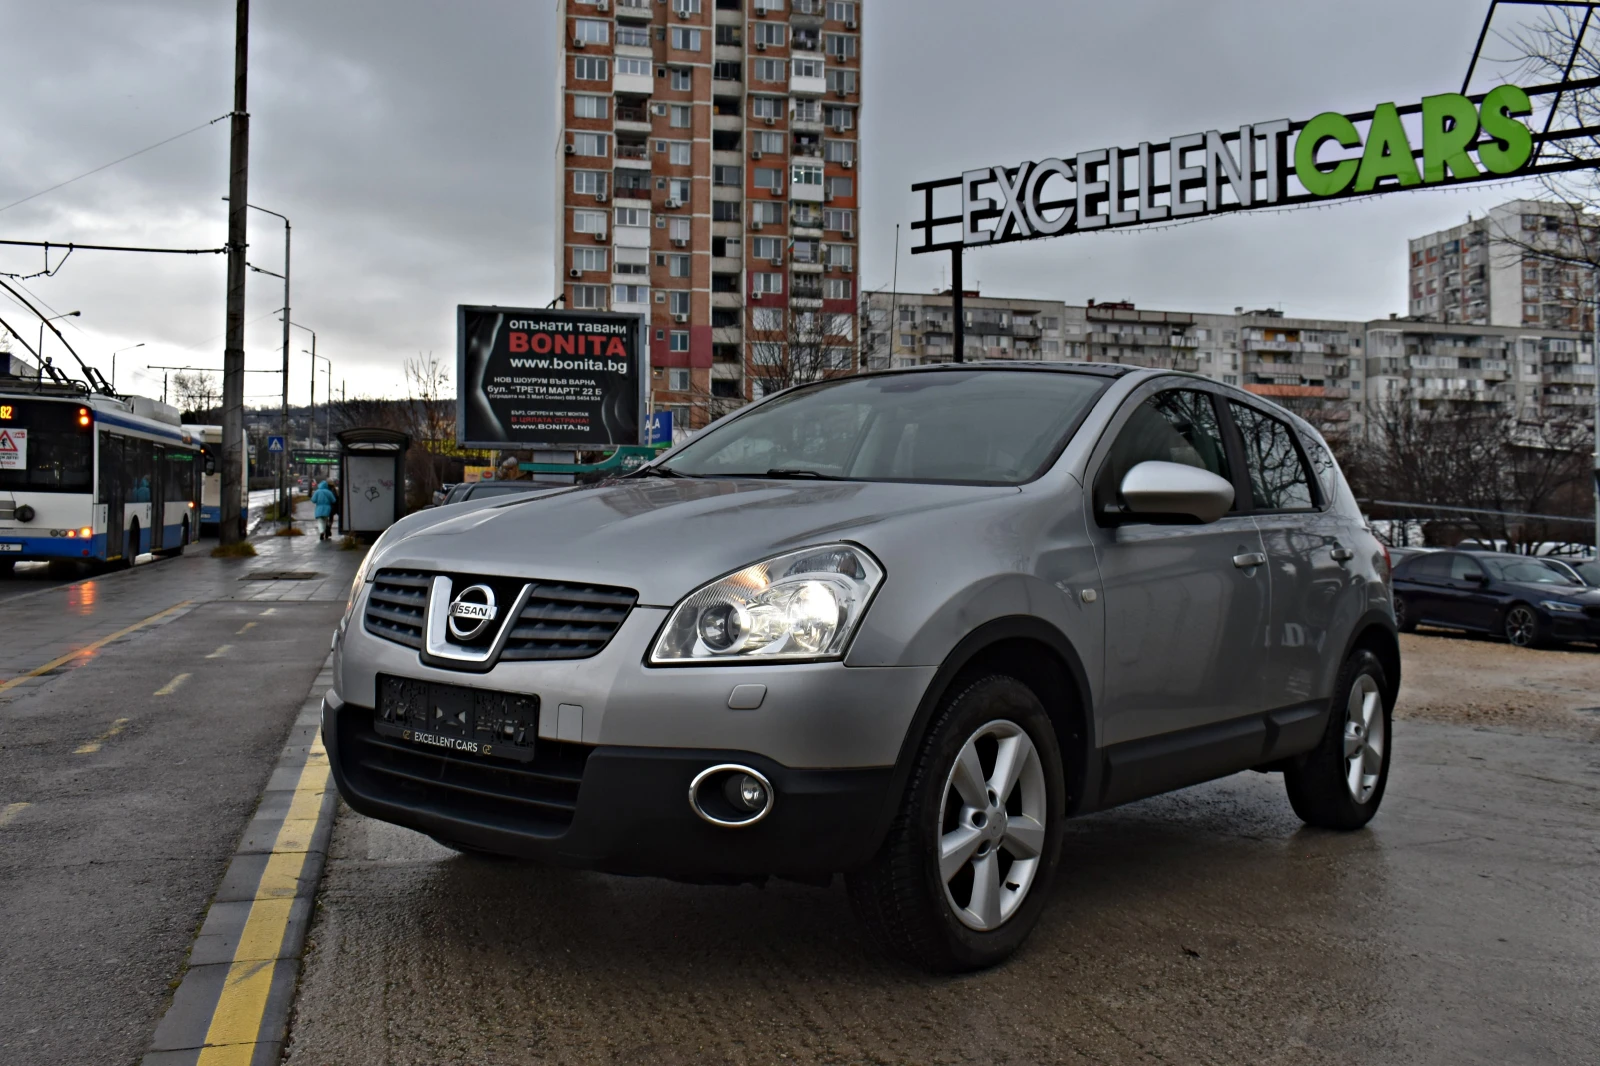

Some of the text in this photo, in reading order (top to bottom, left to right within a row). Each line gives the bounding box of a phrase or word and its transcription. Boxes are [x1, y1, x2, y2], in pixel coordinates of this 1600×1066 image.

[962, 84, 1533, 244] EXCELLENT CARS
[509, 319, 627, 334] опънати тавани
[509, 332, 627, 357] BONITA
[510, 358, 628, 374] www.bonita.bg
[487, 385, 508, 393] бул.
[450, 604, 488, 617] NISSAN
[414, 731, 455, 748] EXCELLENT
[456, 739, 478, 752] CARS
